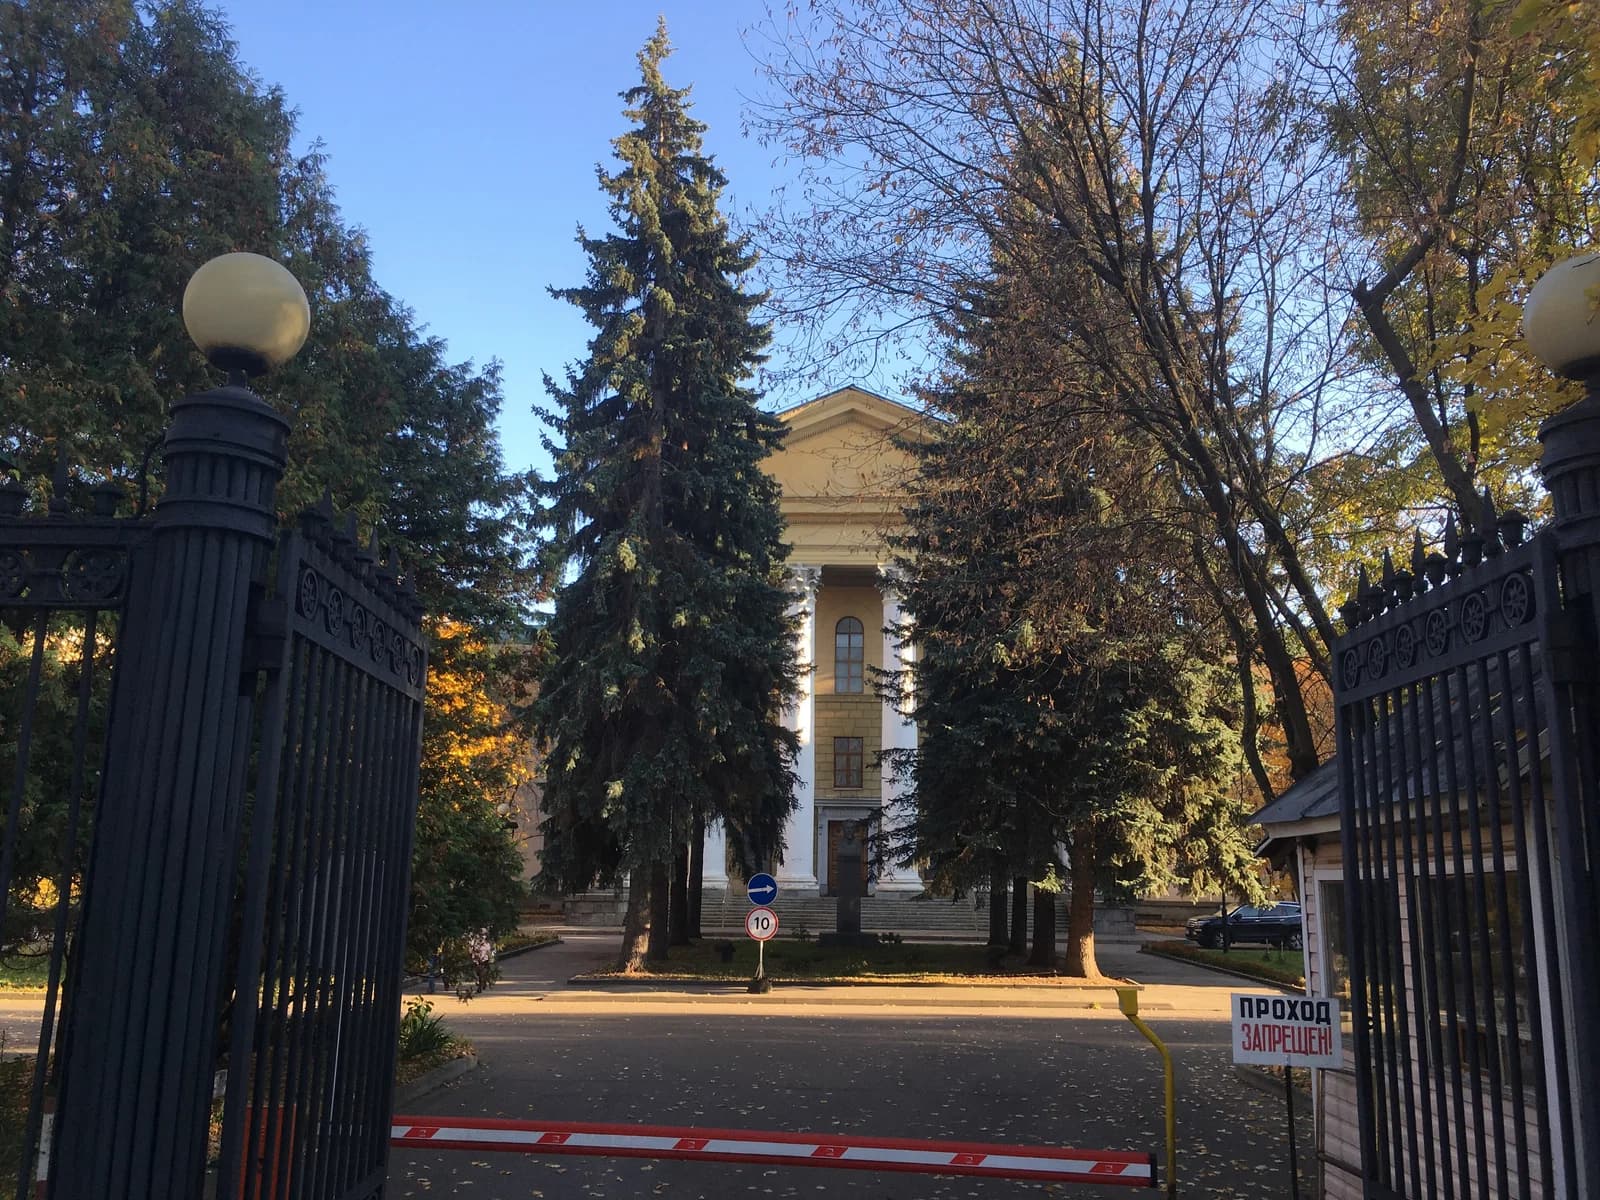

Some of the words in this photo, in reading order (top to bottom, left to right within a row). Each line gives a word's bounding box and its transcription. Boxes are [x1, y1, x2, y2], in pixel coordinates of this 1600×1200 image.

[754, 917, 770, 930] 10
[1240, 997, 1331, 1025] ПРОХОД
[1241, 1023, 1333, 1056] ЗАПРЕЩЕН!
